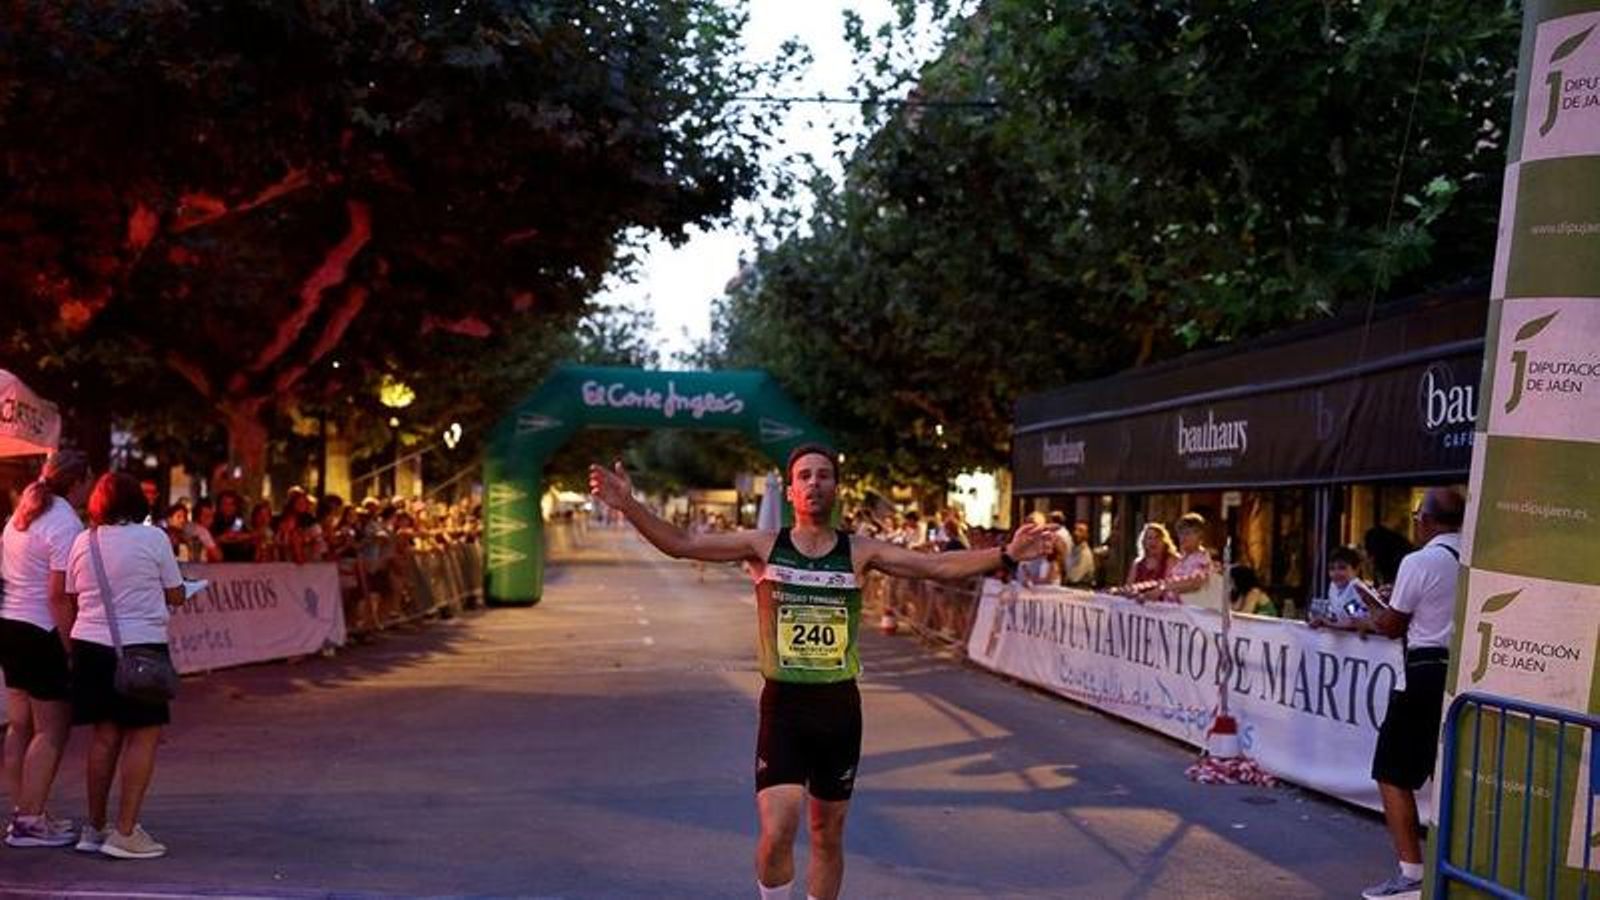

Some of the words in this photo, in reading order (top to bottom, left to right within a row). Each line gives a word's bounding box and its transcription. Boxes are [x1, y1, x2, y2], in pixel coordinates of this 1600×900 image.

[1562, 95, 1581, 110] DE
[1582, 94, 1600, 109] JA
[581, 380, 605, 406] El
[607, 383, 661, 408] Corte
[662, 380, 744, 419] Inglés
[1526, 378, 1544, 392] DE
[1546, 377, 1583, 393] JAÉN
[1427, 372, 1477, 429] bau
[1178, 408, 1248, 456] bauhaus
[206, 579, 278, 613] MARTOS
[791, 624, 836, 647] 240
[1493, 635, 1581, 661] DIPUTACIÓN
[1049, 601, 1208, 681] AYUNTAMIENTO
[1261, 640, 1397, 732] MARTO
[1490, 652, 1509, 666] DE
[1510, 655, 1547, 673] JAÉN
